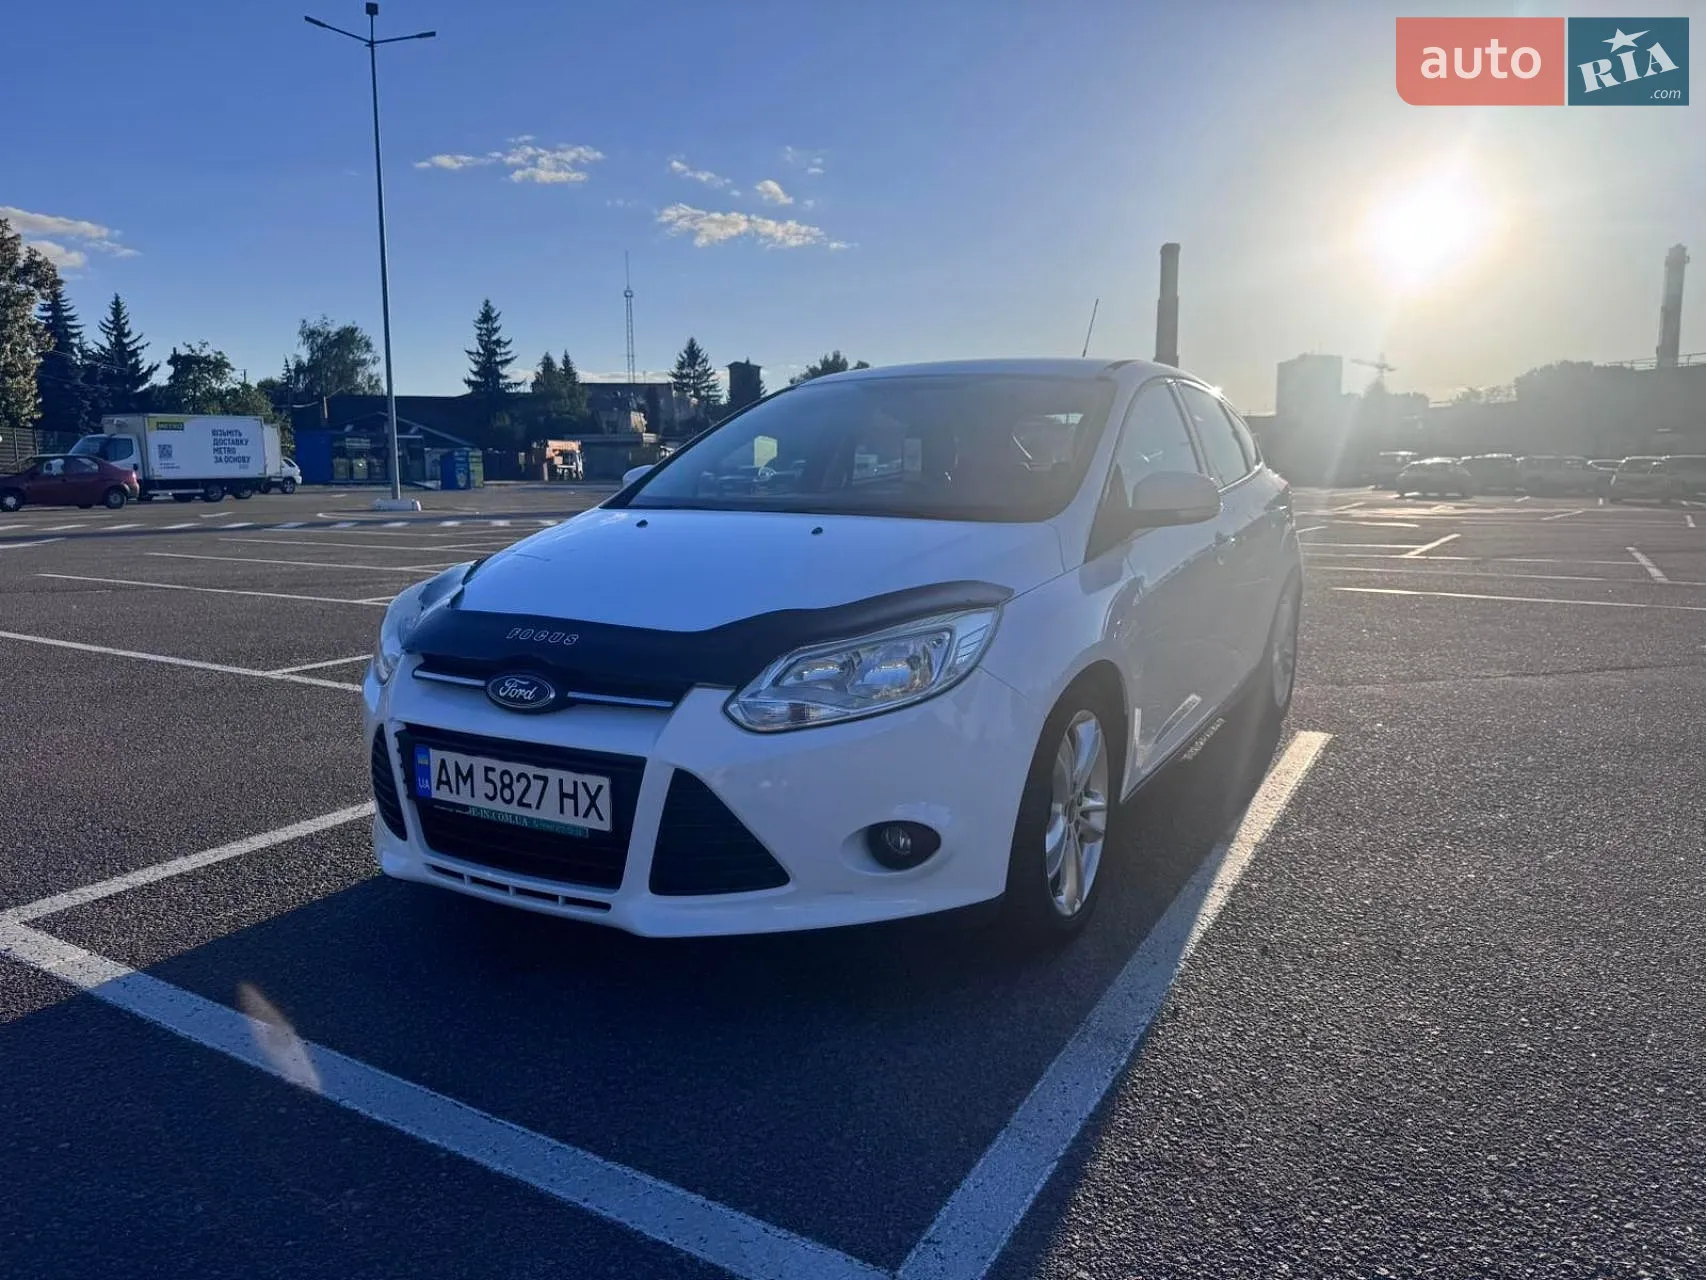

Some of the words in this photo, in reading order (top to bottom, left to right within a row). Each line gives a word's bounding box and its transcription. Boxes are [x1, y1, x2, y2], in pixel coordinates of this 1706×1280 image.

[213, 438, 249, 446] ДОСТАВКУ
[213, 446, 237, 455] METRO
[214, 455, 224, 464] ЗА
[224, 455, 251, 464] ОСНОВУ
[505, 627, 580, 646] FOCUS
[499, 677, 538, 701] Ford
[418, 777, 430, 790] UA
[435, 758, 476, 798] AM
[484, 766, 549, 811] 5827
[558, 778, 605, 822] HX
